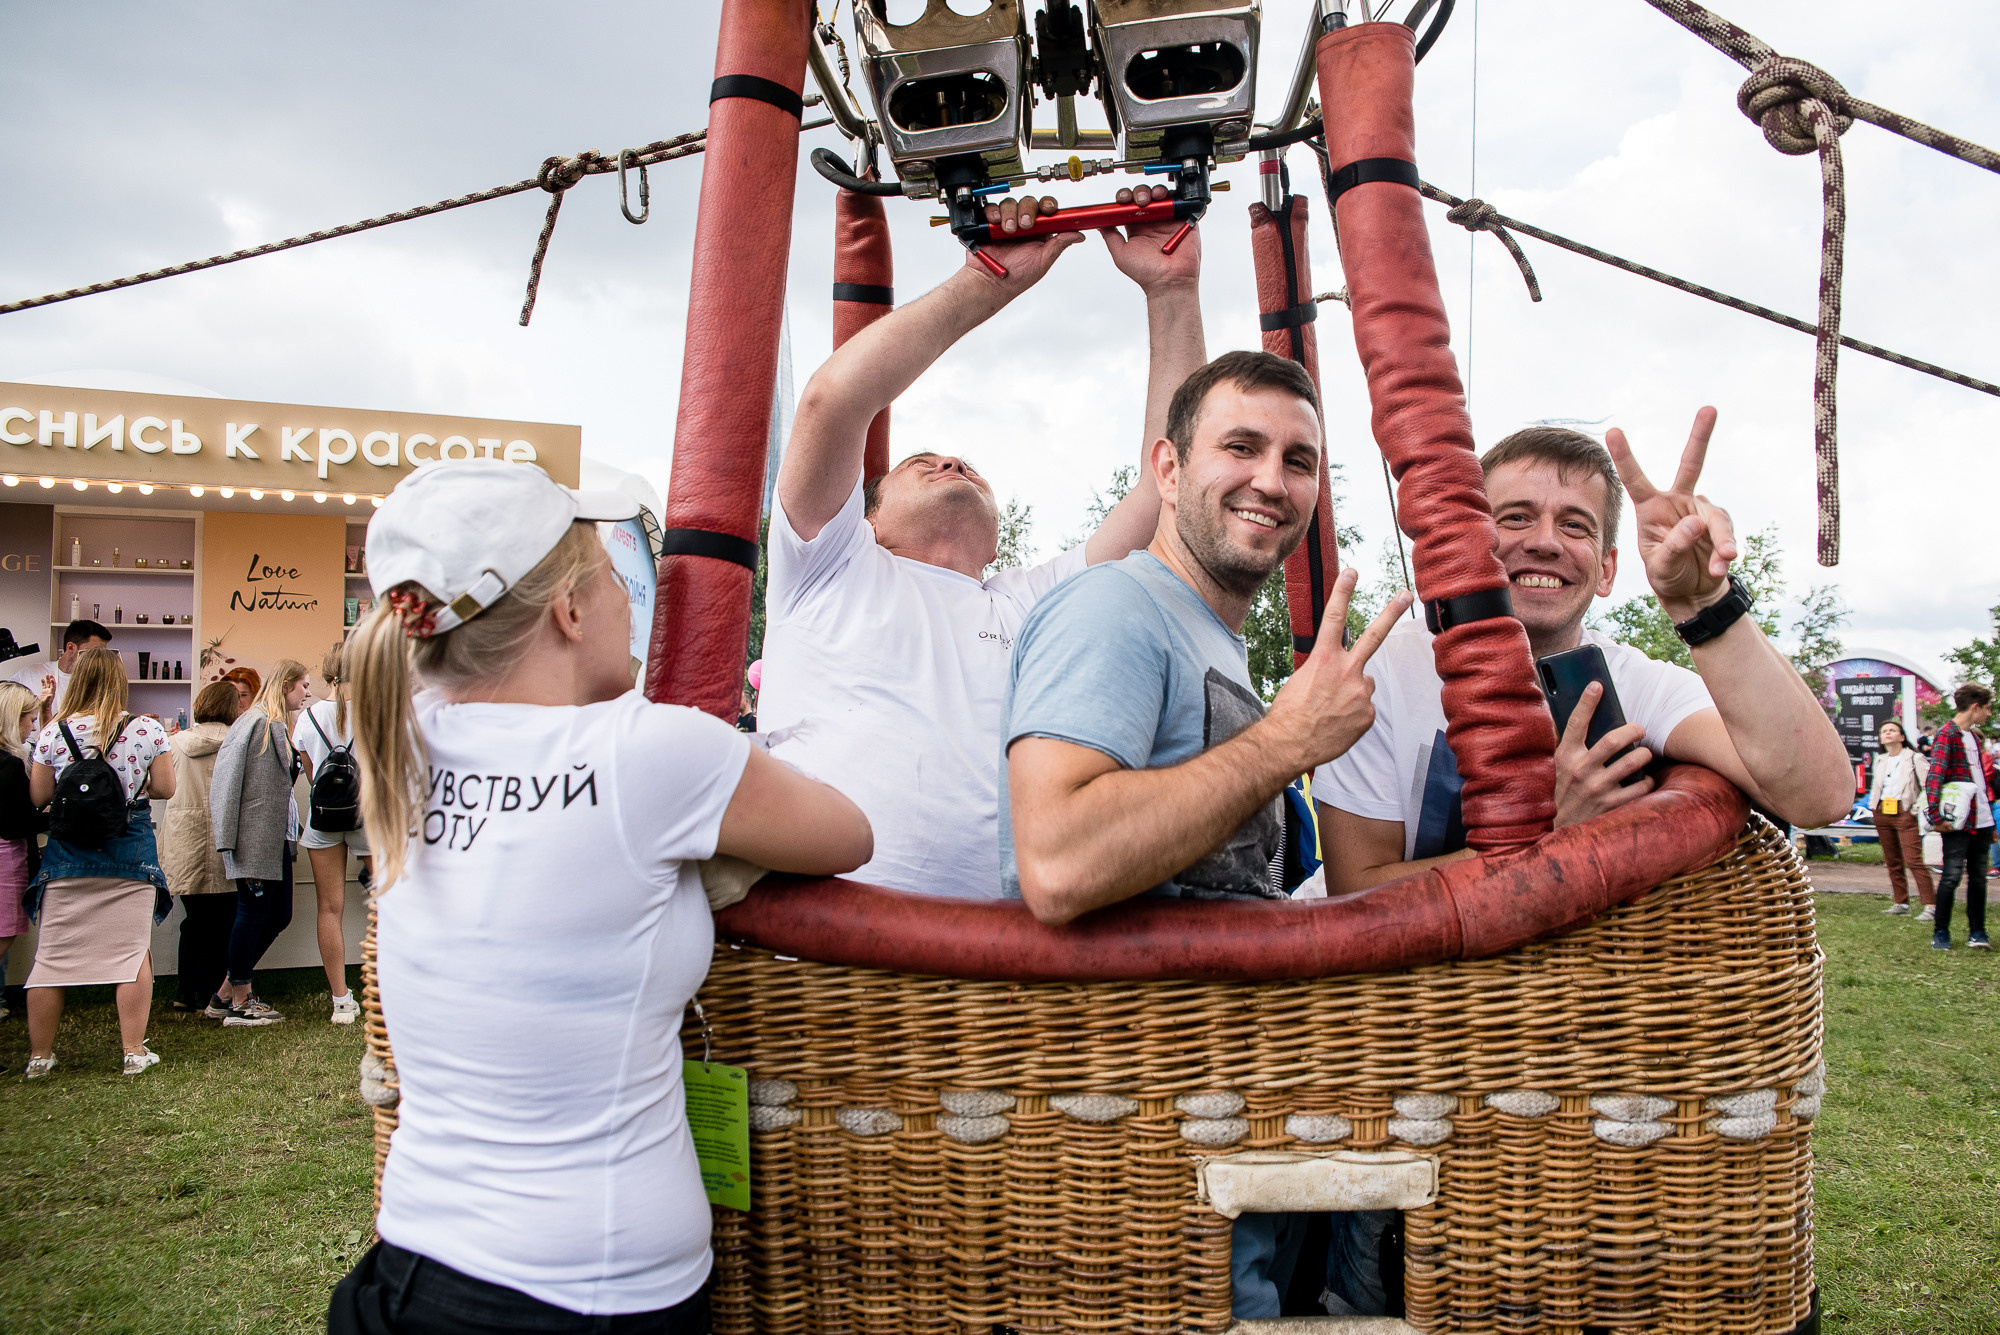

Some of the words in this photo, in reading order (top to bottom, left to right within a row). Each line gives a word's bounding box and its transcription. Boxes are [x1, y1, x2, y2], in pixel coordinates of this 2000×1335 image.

[0, 406, 202, 456] снись
[225, 421, 261, 460] к
[280, 427, 537, 480] красоте
[247, 553, 303, 582] Love
[230, 584, 318, 612] Nature
[424, 763, 598, 812] УВСТВУЙ
[422, 809, 487, 852] ОТУ
